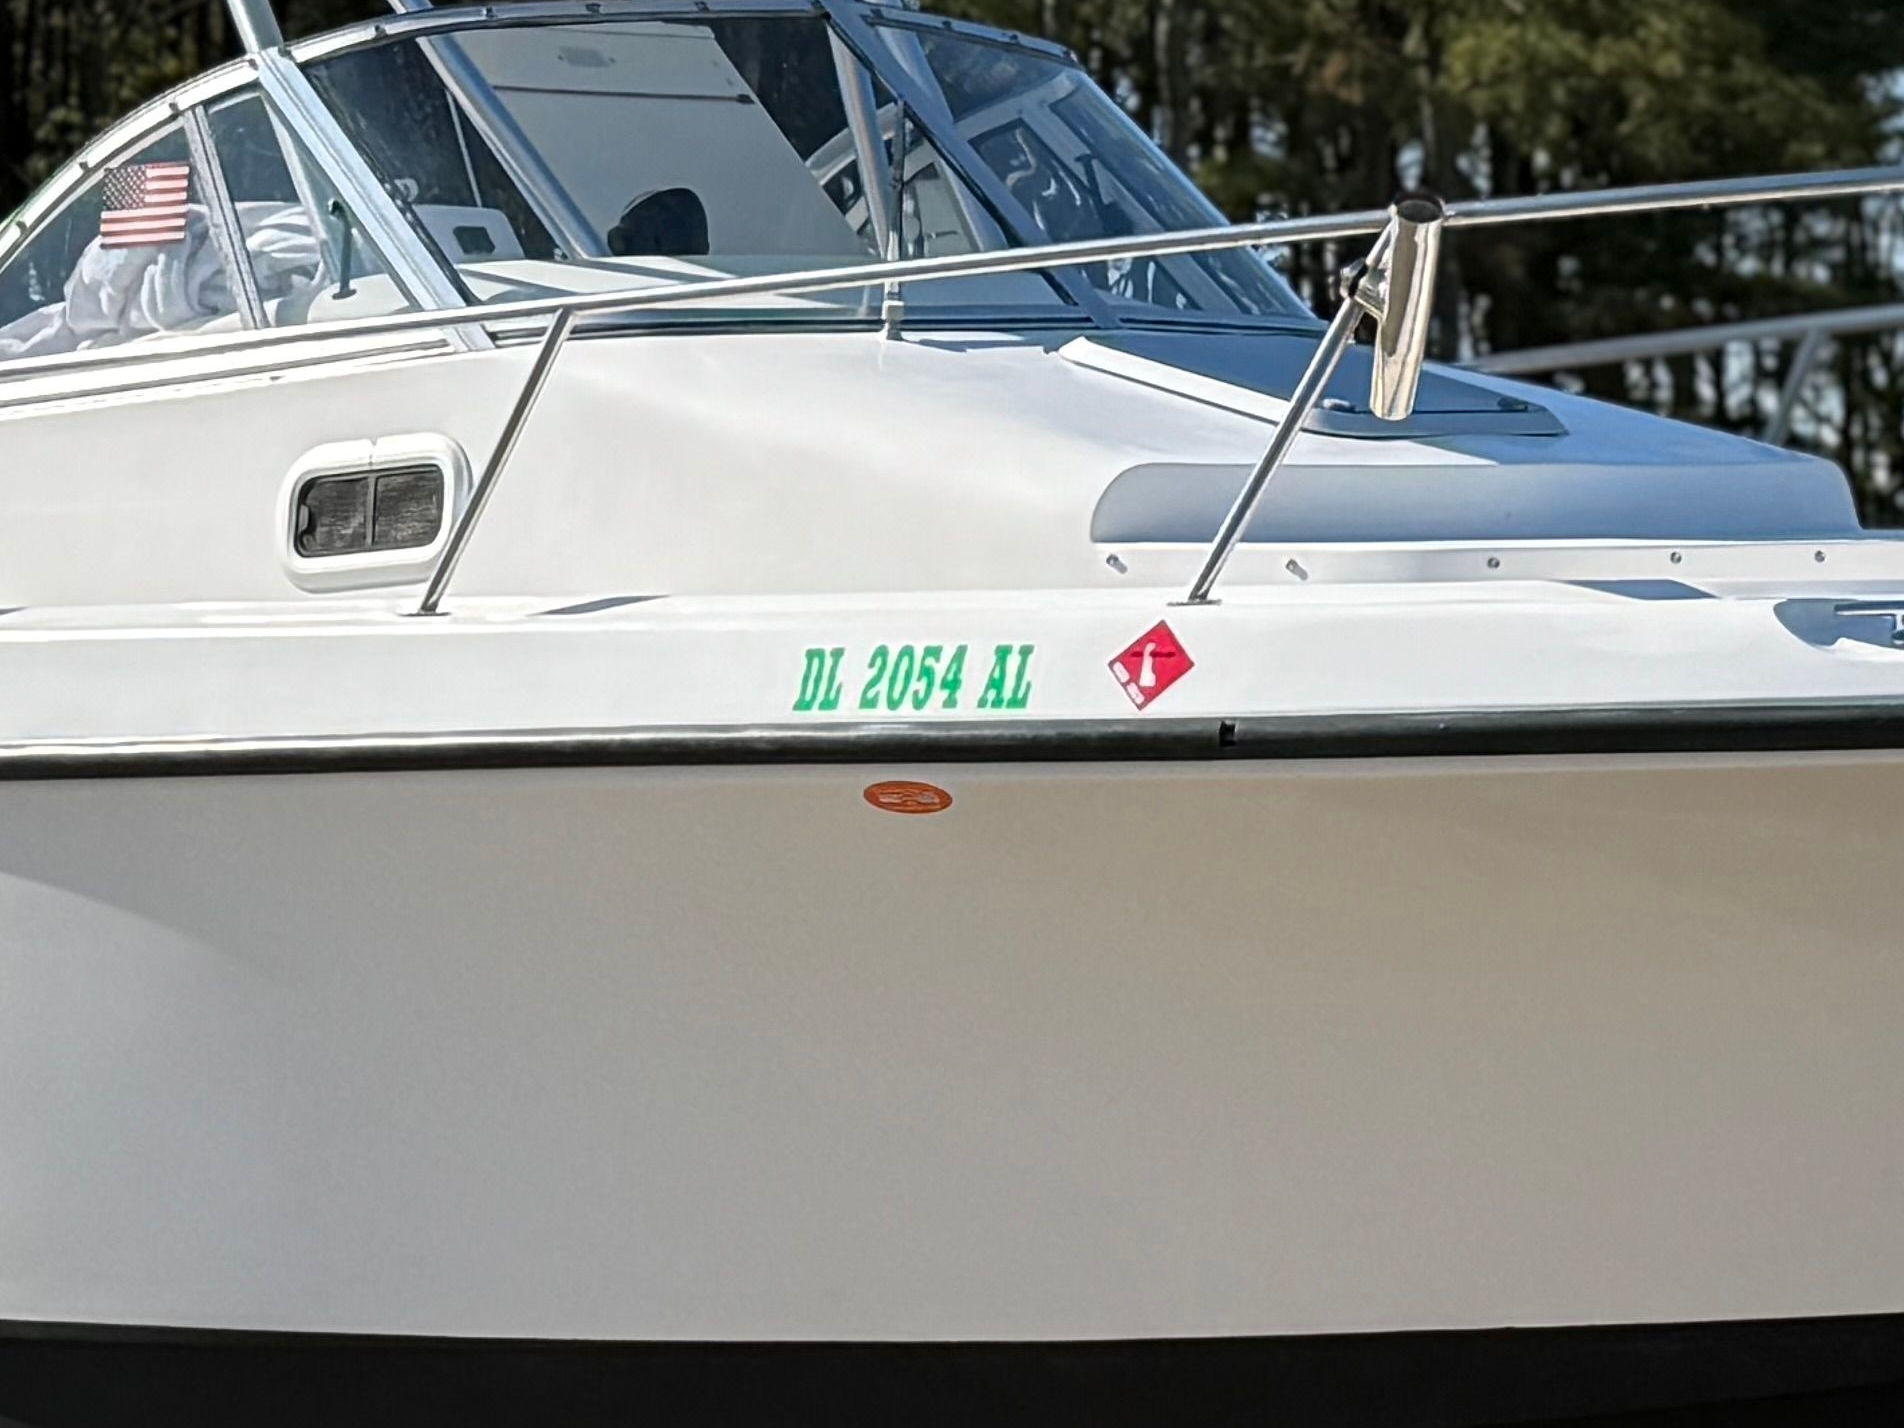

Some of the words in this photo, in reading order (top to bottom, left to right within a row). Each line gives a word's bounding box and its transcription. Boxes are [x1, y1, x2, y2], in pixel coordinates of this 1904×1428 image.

[792, 647, 845, 711] DL
[858, 644, 968, 711] 2054
[976, 644, 1035, 709] AL
